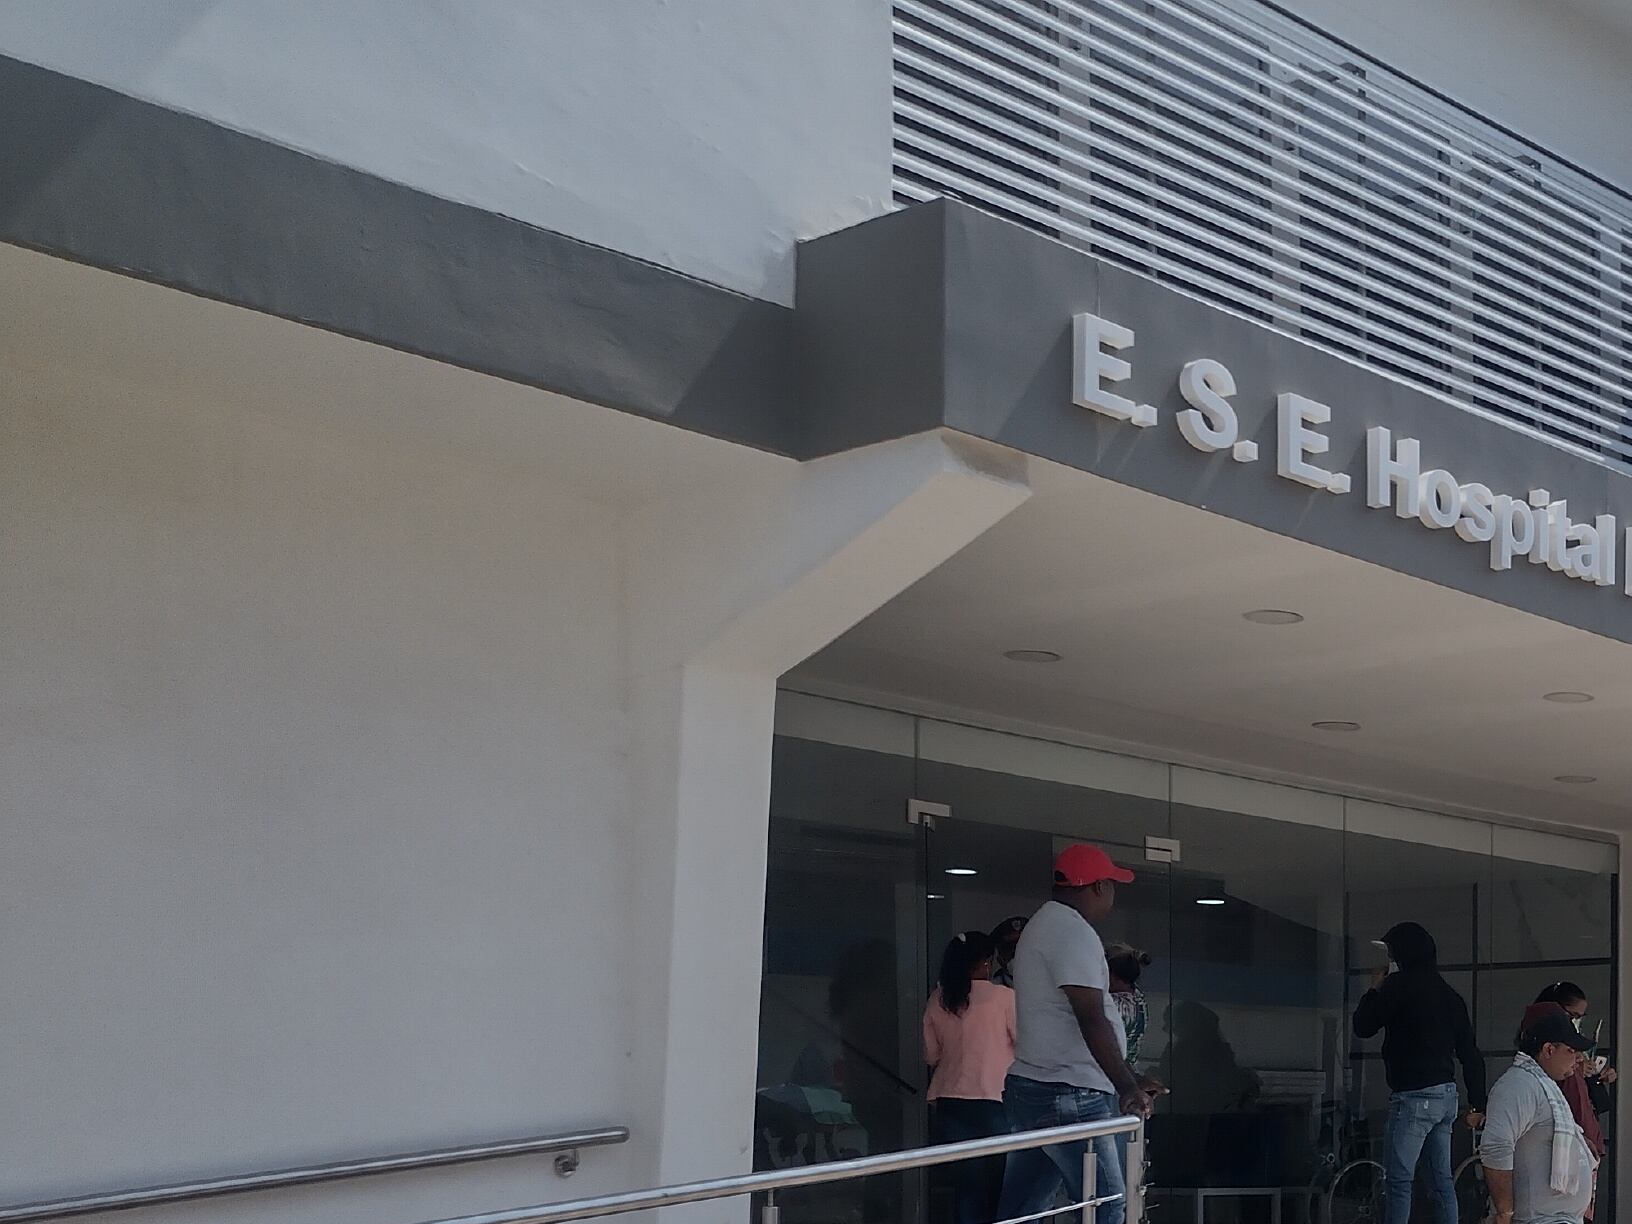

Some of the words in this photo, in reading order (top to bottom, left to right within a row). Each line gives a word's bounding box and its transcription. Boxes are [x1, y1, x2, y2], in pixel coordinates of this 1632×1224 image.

[1073, 313, 1157, 427] E.
[1176, 358, 1258, 462] S.
[1277, 392, 1351, 494] E.
[1366, 425, 1616, 586] Hospital
